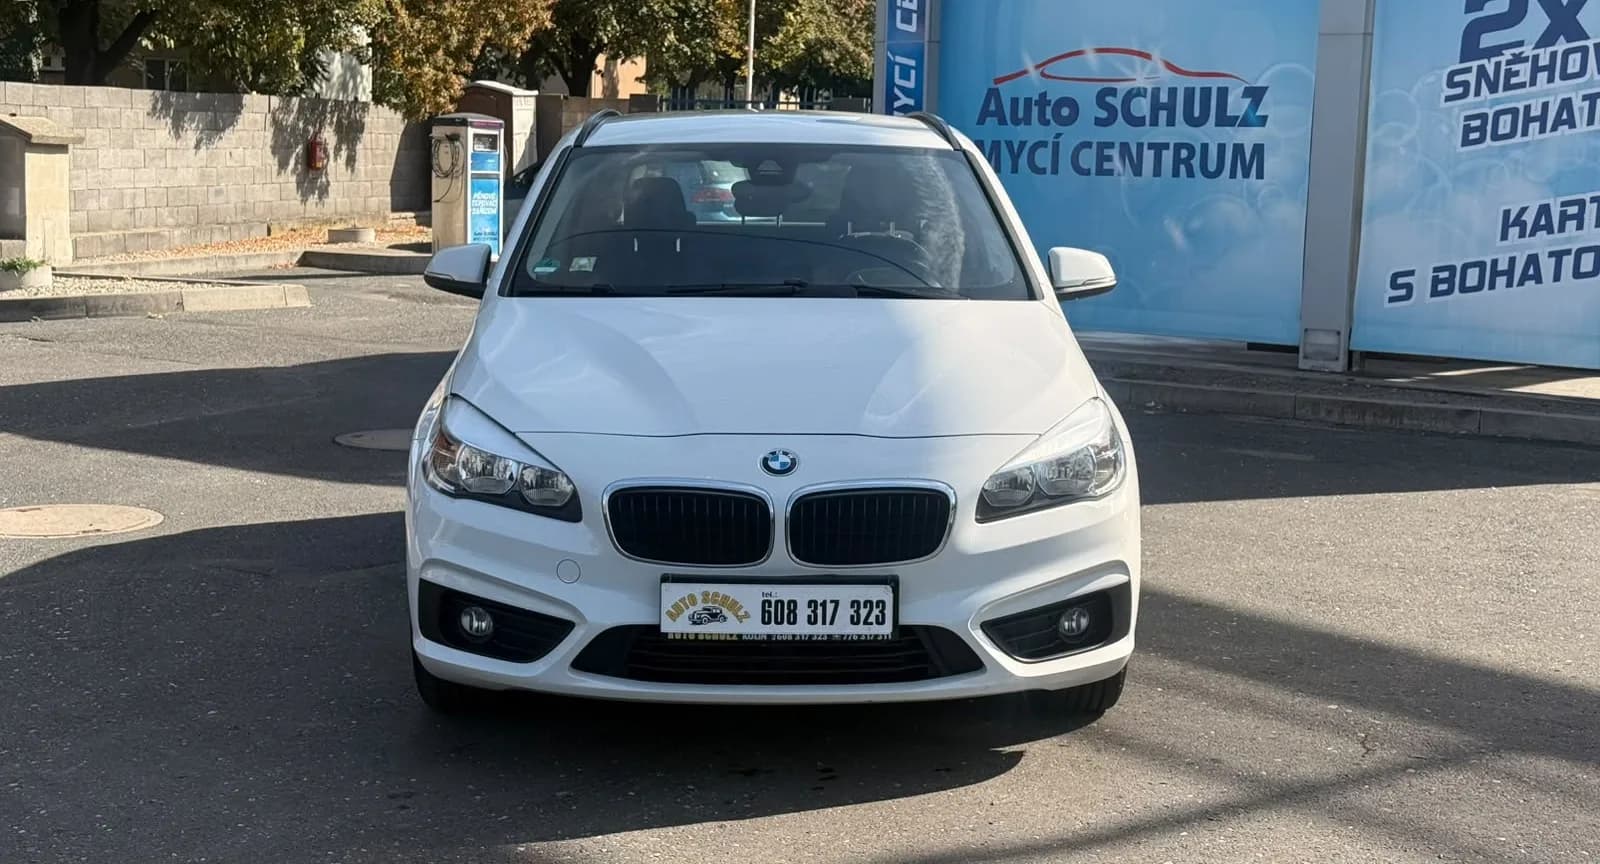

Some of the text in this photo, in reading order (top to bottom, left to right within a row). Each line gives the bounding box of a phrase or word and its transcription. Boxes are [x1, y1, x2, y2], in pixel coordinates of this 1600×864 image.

[887, 51, 915, 116] YCÍ
[976, 86, 1269, 128] Auto SCHULZ
[1070, 140, 1265, 180] CENTRUM
[1388, 269, 1416, 304] S
[665, 590, 751, 624] AUTO SCHULZ
[761, 599, 886, 626] 608 317 323
